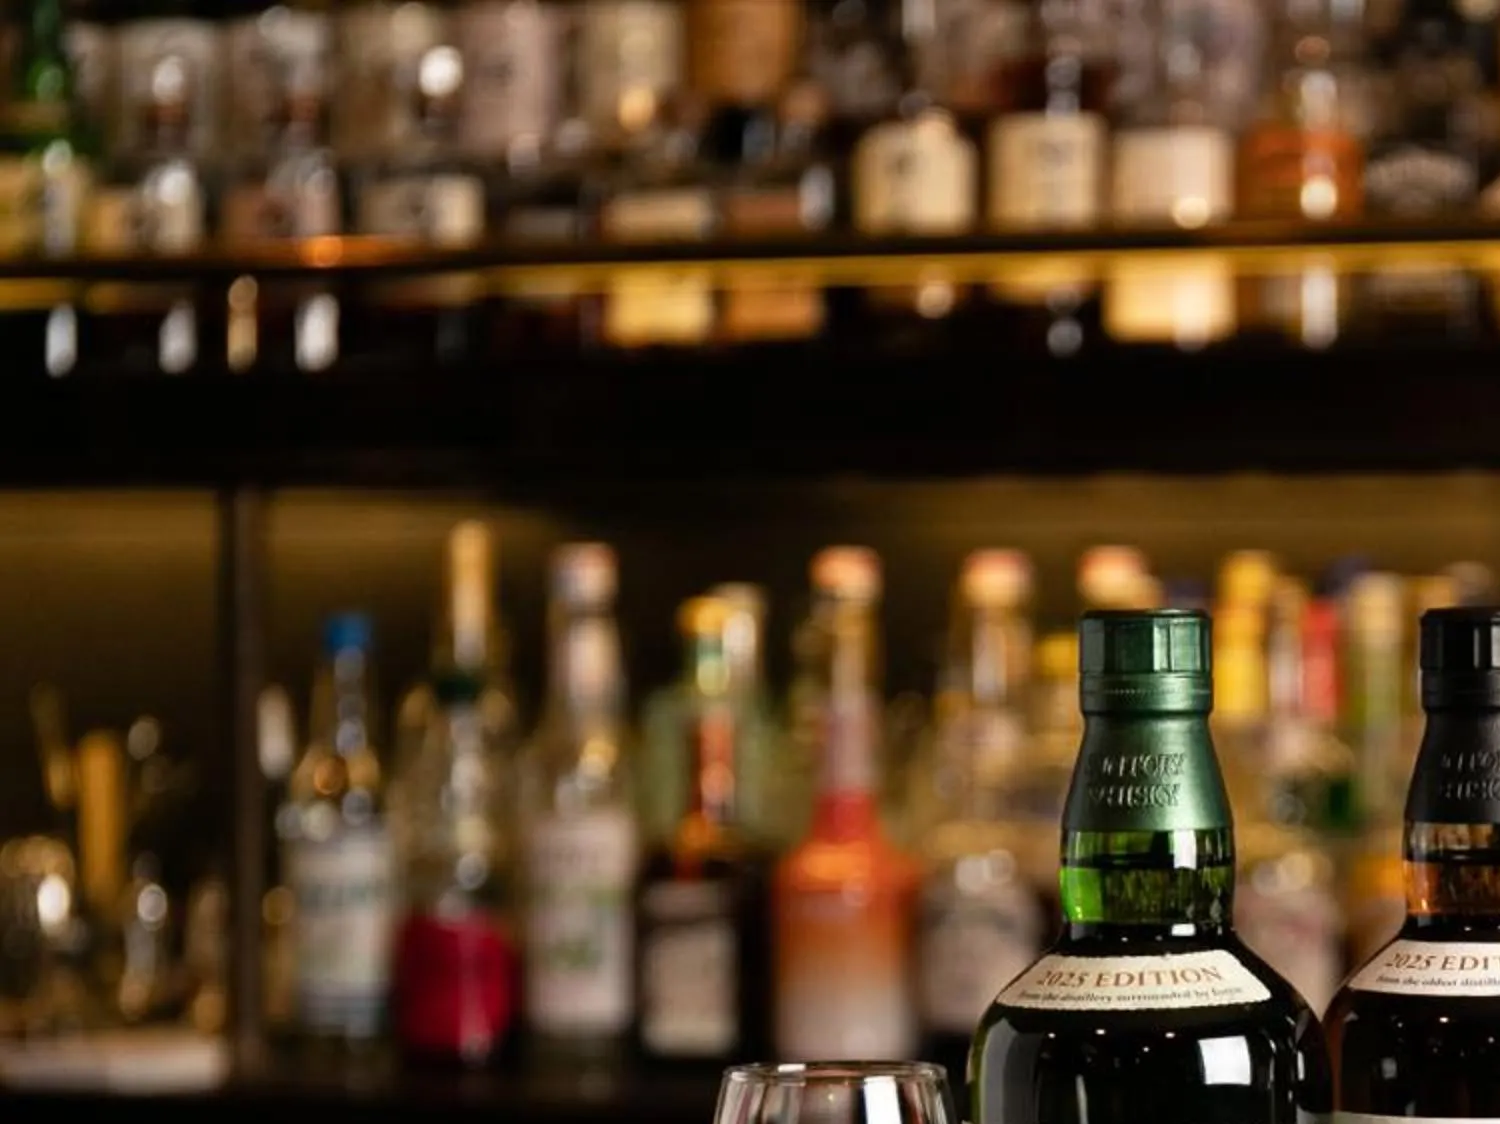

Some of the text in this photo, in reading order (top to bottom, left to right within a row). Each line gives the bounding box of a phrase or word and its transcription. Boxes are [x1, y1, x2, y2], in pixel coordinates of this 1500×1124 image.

[1384, 953, 1437, 970] 2025
[1037, 966, 1223, 988] 2025 EDITION
